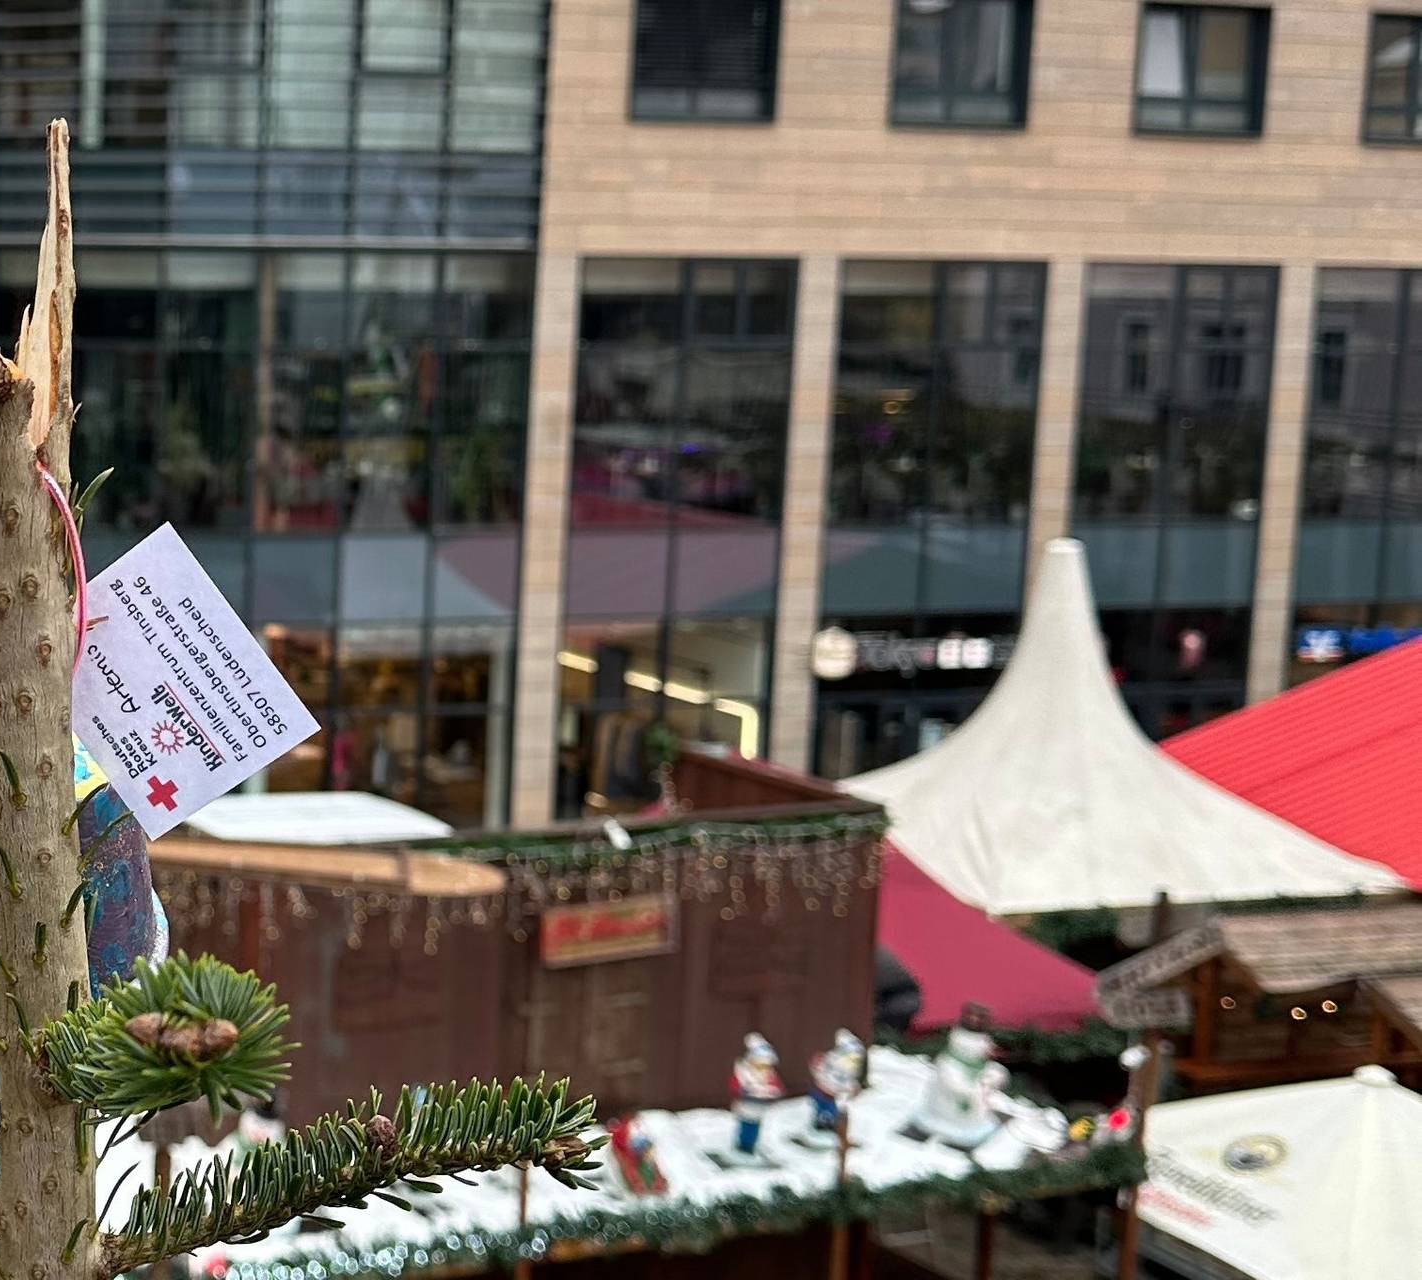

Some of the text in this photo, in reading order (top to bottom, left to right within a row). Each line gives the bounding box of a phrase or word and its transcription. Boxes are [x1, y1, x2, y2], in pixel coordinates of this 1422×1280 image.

[109, 579, 248, 762] Familienzentrum Tinsberg
[133, 576, 267, 748] Obertinsbergerstraße 46
[178, 597, 288, 736] 58507 Lüdenscheid
[91, 715, 140, 780] Deutsches
[120, 736, 149, 773] Rotes
[128, 729, 158, 767] Kreuz
